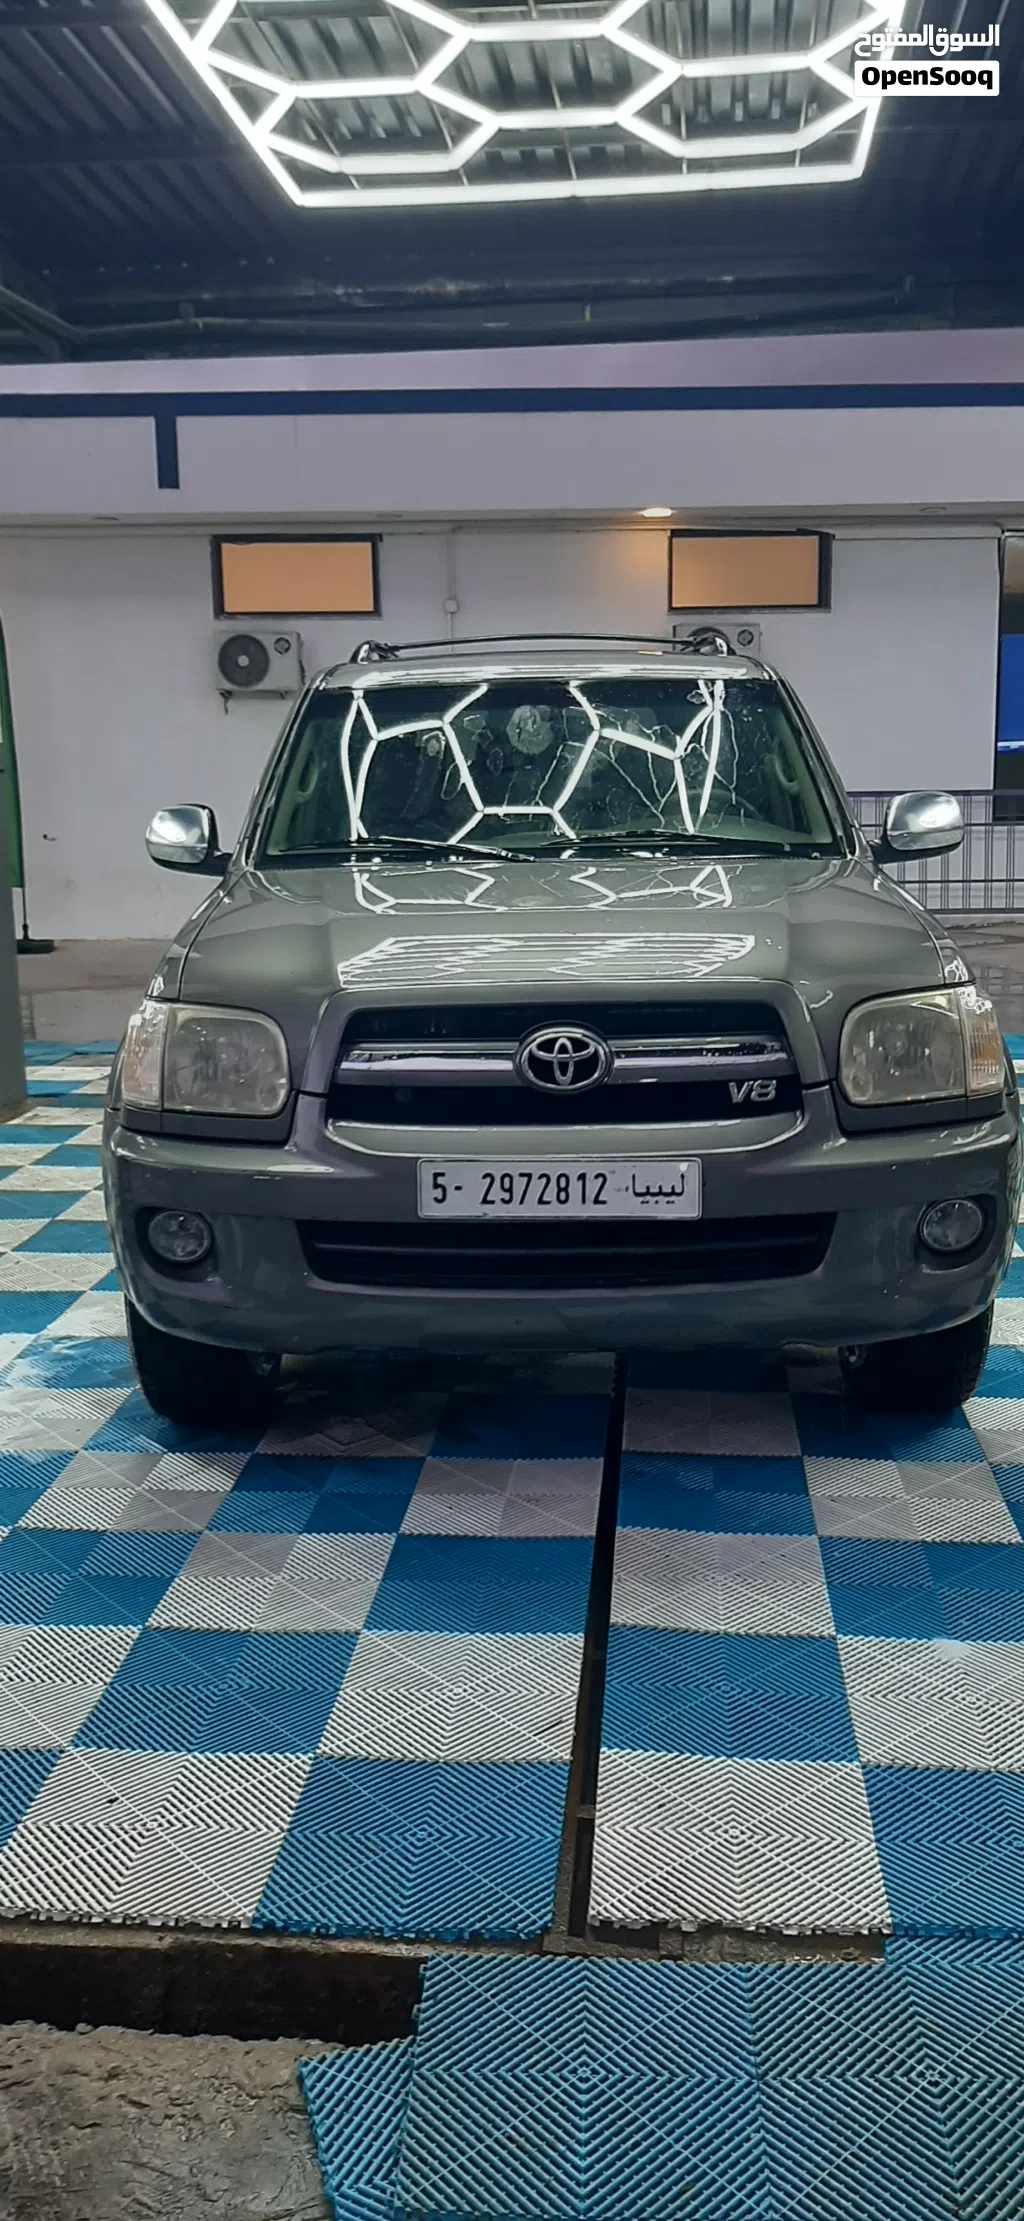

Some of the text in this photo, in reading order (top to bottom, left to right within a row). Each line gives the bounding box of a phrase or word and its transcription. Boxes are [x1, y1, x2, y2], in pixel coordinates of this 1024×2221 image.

[728, 1080, 777, 1103] V8
[479, 1172, 608, 1205] 2972812
[631, 1173, 685, 1205] ليبيا
